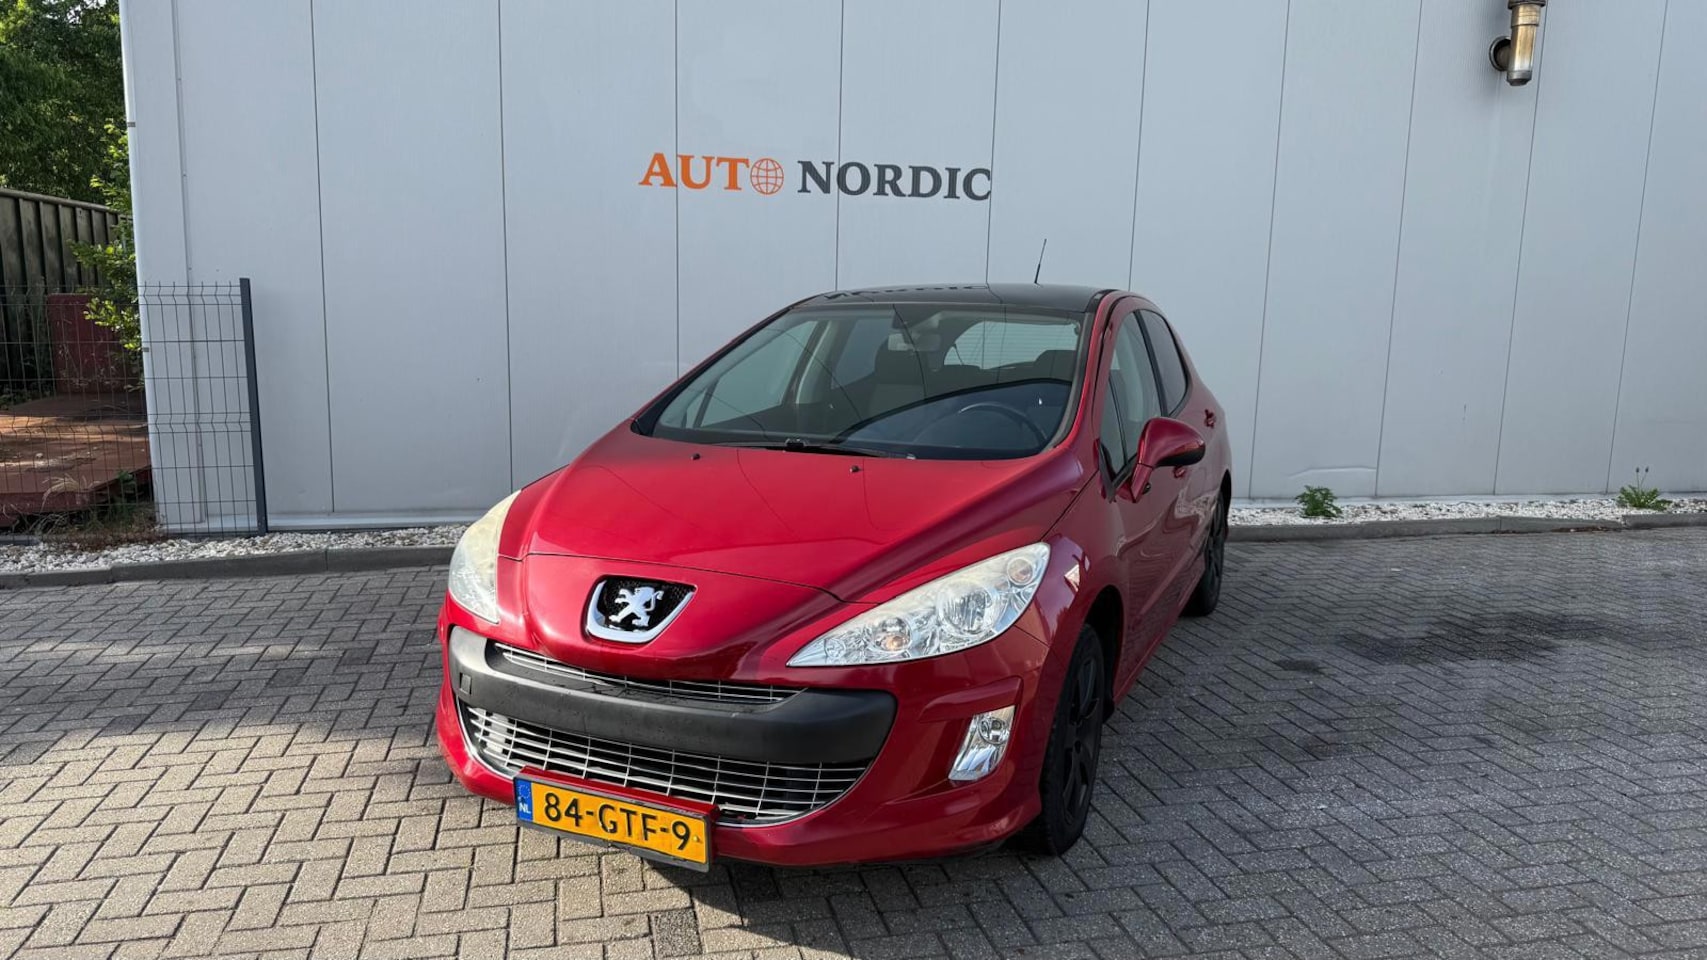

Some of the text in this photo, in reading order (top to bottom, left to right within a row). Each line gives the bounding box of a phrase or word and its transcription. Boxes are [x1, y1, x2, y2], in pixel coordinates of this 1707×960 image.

[797, 160, 991, 201] NORDIC
[518, 801, 531, 814] NL
[544, 792, 690, 850] 84-GTF-9
